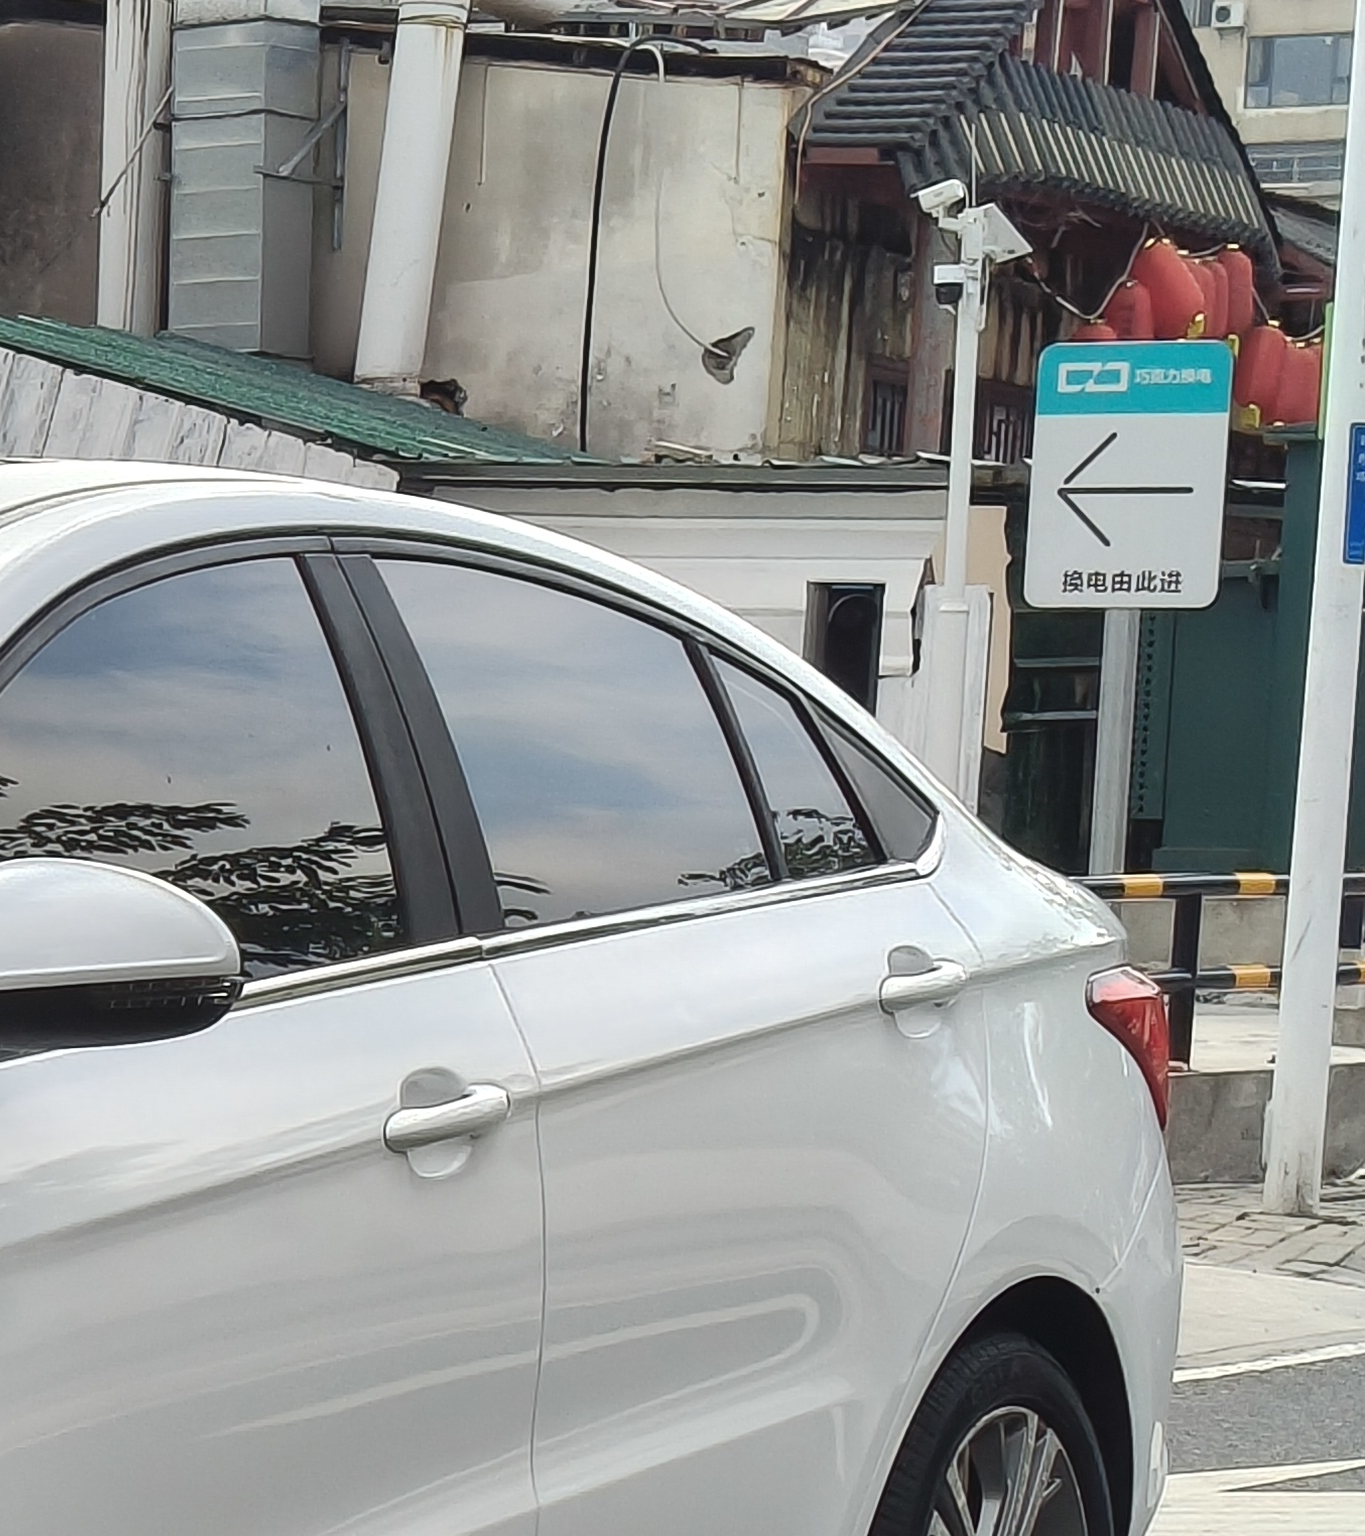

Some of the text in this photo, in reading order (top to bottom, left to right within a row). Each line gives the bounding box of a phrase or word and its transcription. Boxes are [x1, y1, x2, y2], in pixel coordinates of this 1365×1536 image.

[1062, 571, 1182, 593] 换电由此进
